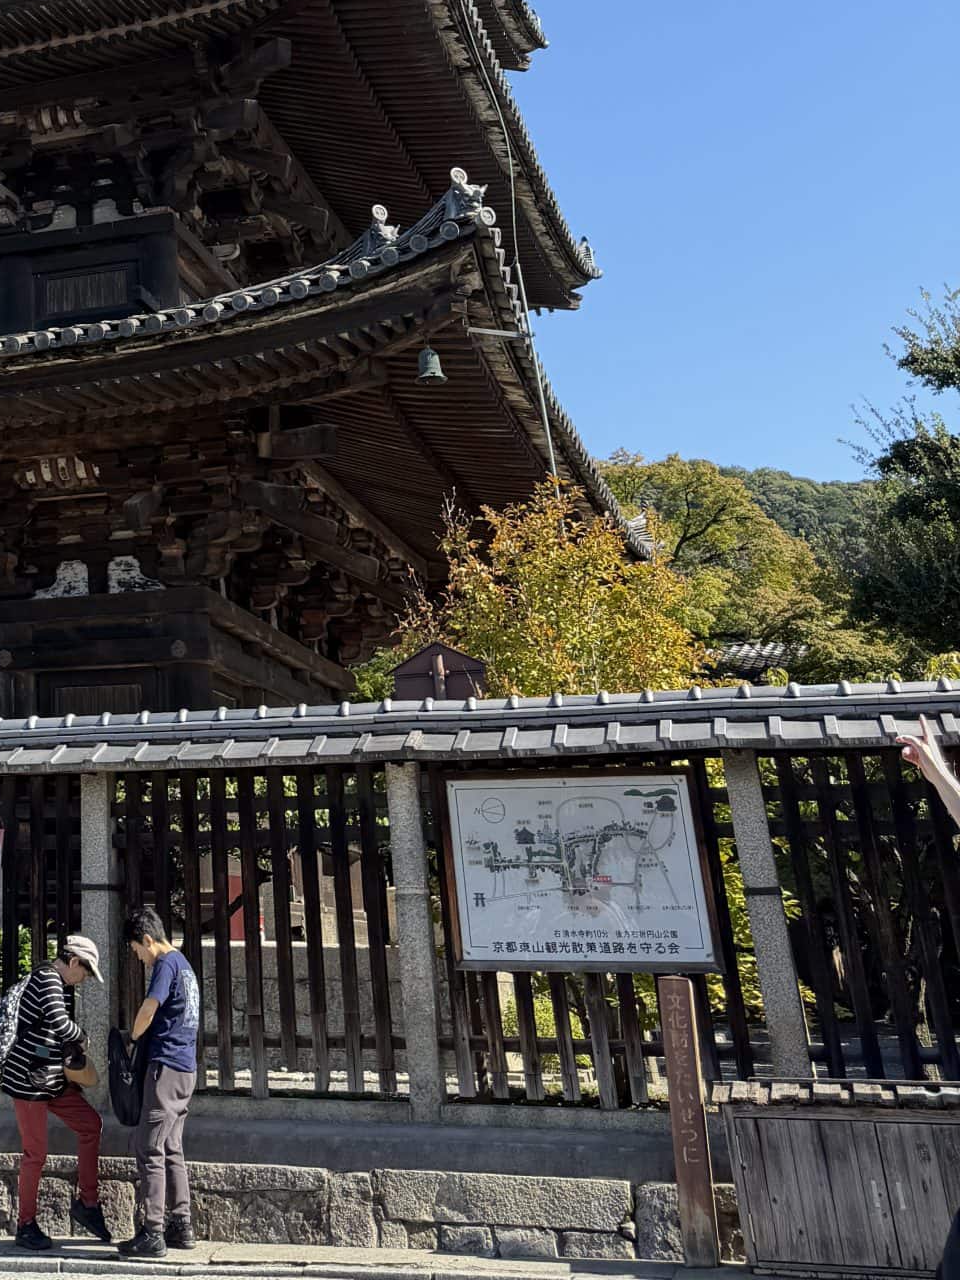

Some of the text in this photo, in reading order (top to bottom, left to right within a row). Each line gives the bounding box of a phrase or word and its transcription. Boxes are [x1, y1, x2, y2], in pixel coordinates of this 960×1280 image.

[492, 940, 681, 955] 京都東山観光散策道路を守る会
